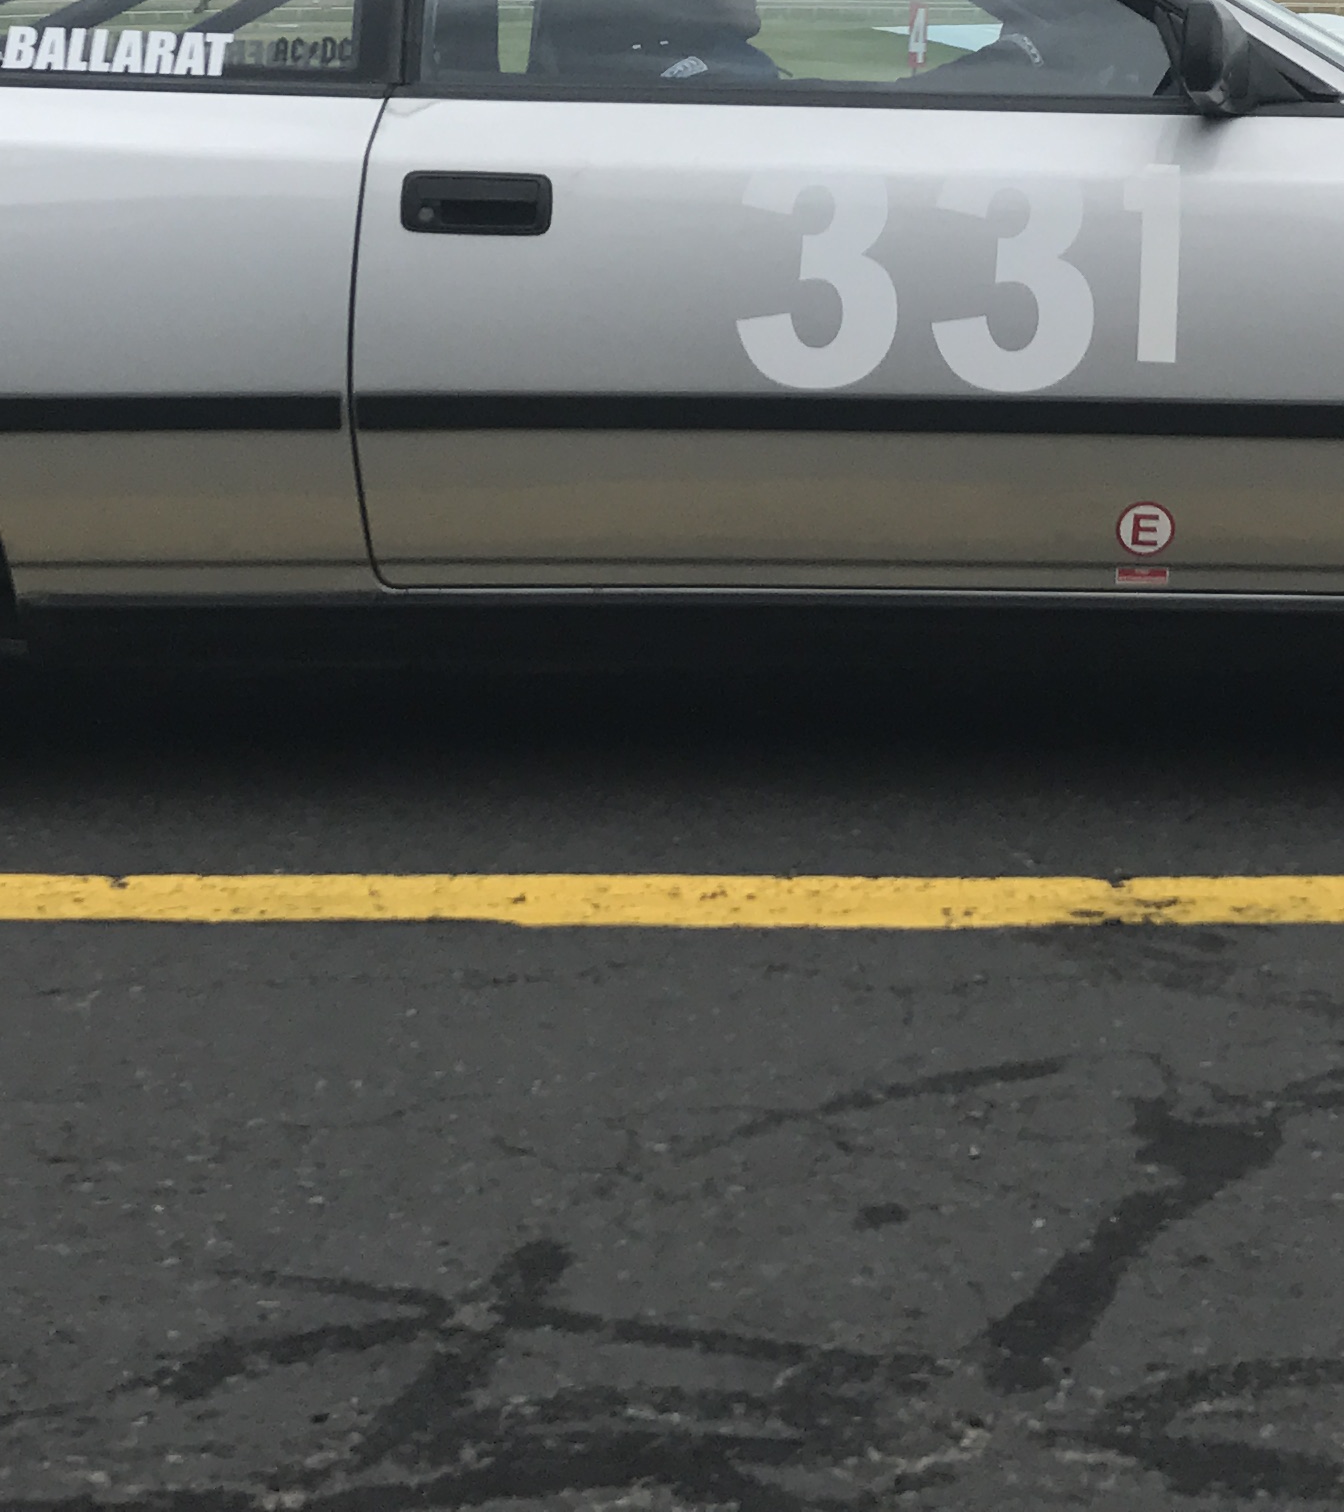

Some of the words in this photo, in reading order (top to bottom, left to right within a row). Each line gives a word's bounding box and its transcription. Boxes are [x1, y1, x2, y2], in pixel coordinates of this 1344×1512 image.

[2, 26, 234, 76] BALLARAT
[908, 7, 928, 64] 4
[736, 160, 1180, 392] 331
[1131, 513, 1159, 546] E
